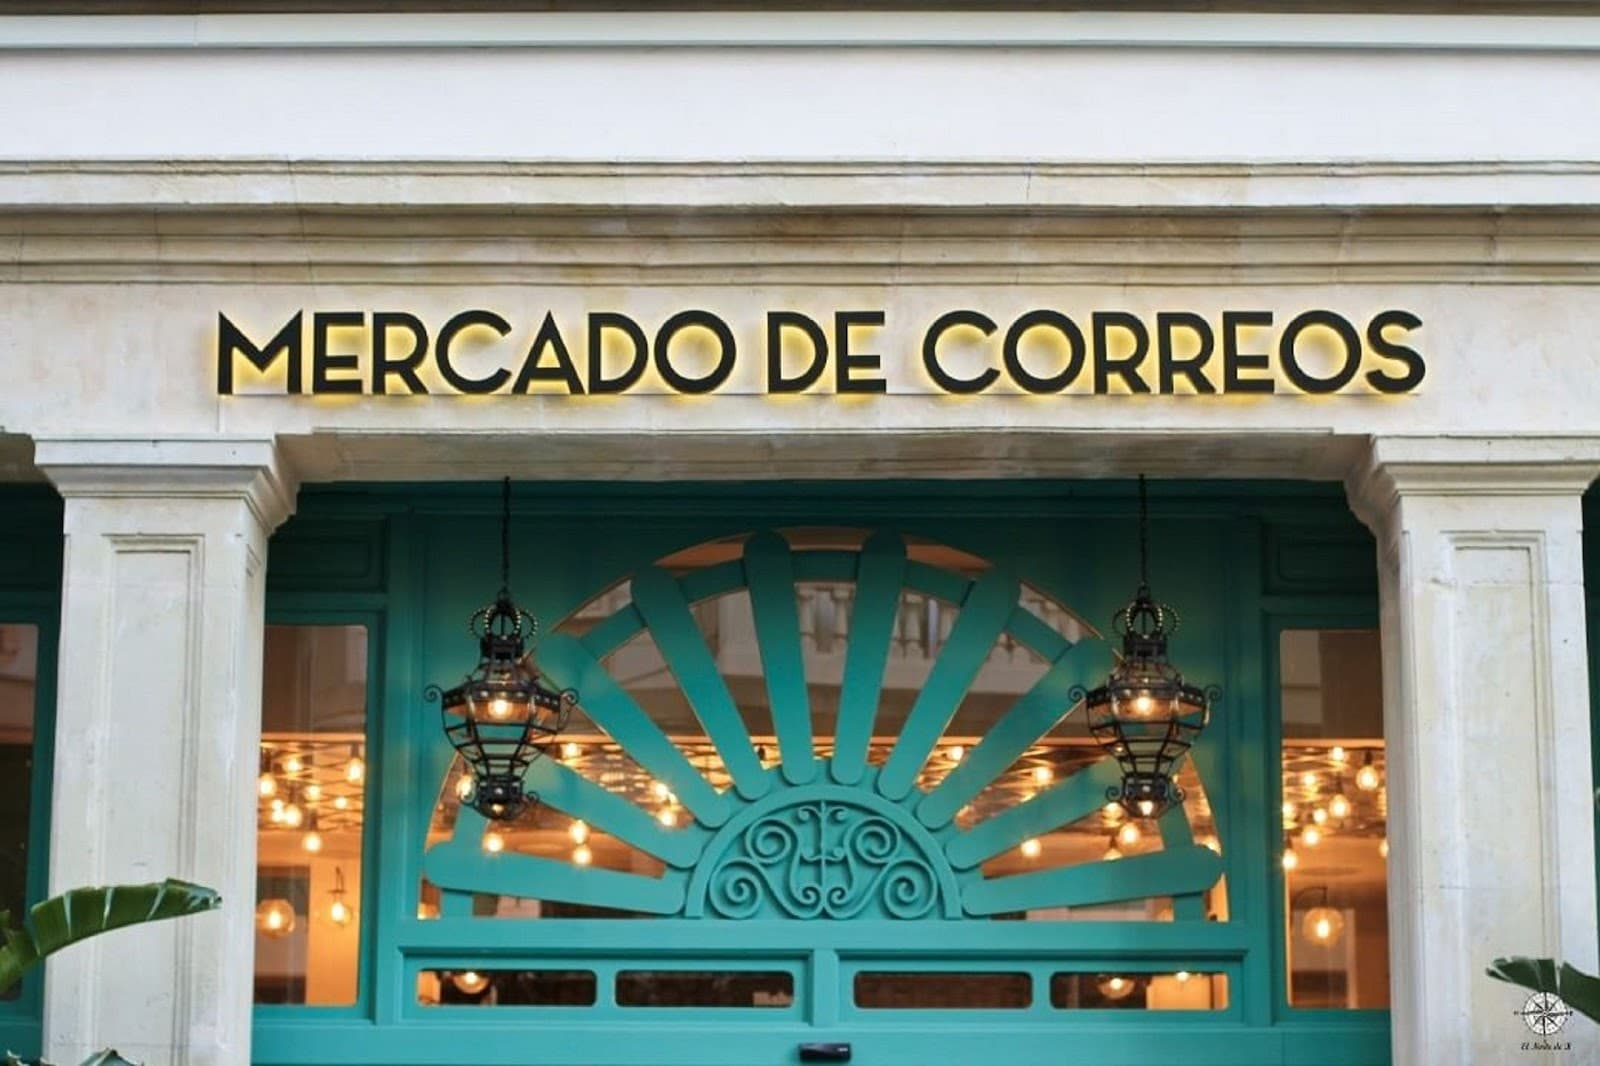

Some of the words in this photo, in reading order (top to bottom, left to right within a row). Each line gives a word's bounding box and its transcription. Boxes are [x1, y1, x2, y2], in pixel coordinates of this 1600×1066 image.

[217, 310, 736, 395] MERCADO
[767, 311, 887, 394] DE
[922, 310, 1426, 395] CORREOS
